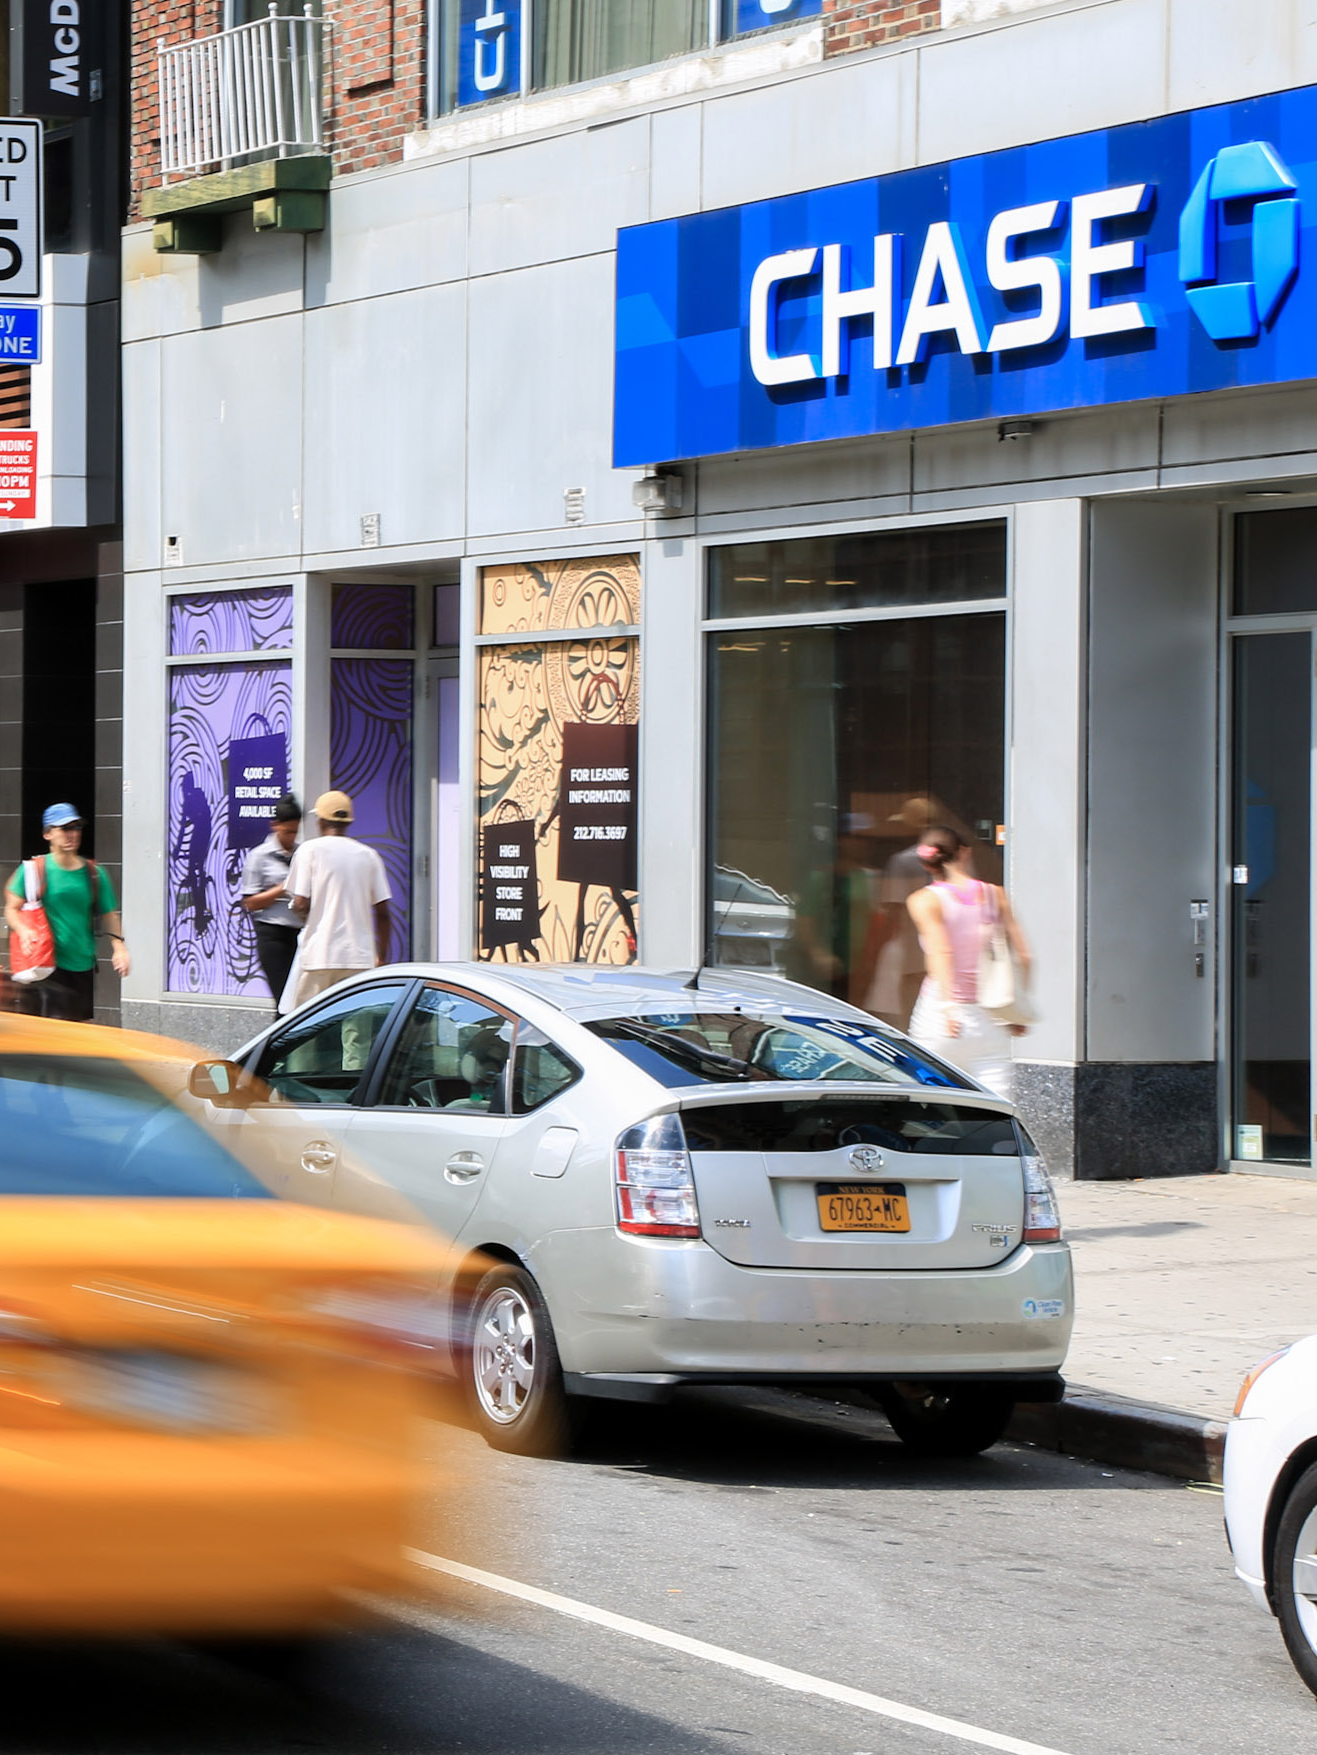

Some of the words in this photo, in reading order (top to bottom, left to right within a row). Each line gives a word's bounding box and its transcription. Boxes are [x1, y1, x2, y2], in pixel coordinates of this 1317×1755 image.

[750, 183, 1154, 386] CHASE
[243, 767, 262, 781] 4,000
[263, 767, 274, 779] SF
[570, 769, 589, 782] FOR
[590, 768, 629, 782] LEASING
[235, 786, 258, 798] RETAIL
[258, 786, 282, 798] SPACE
[569, 790, 631, 803] INFORMATION
[239, 805, 277, 818] AVAILABLE
[573, 826, 628, 840] 212.716.3697
[499, 844, 520, 858] HIGH
[490, 866, 529, 879] VISIBILITY
[496, 887, 523, 900] STORE
[495, 907, 523, 920] FRONT
[838, 1186, 859, 1194] NEW
[862, 1186, 885, 1194] YORK
[972, 1223, 1018, 1233] PRIUS
